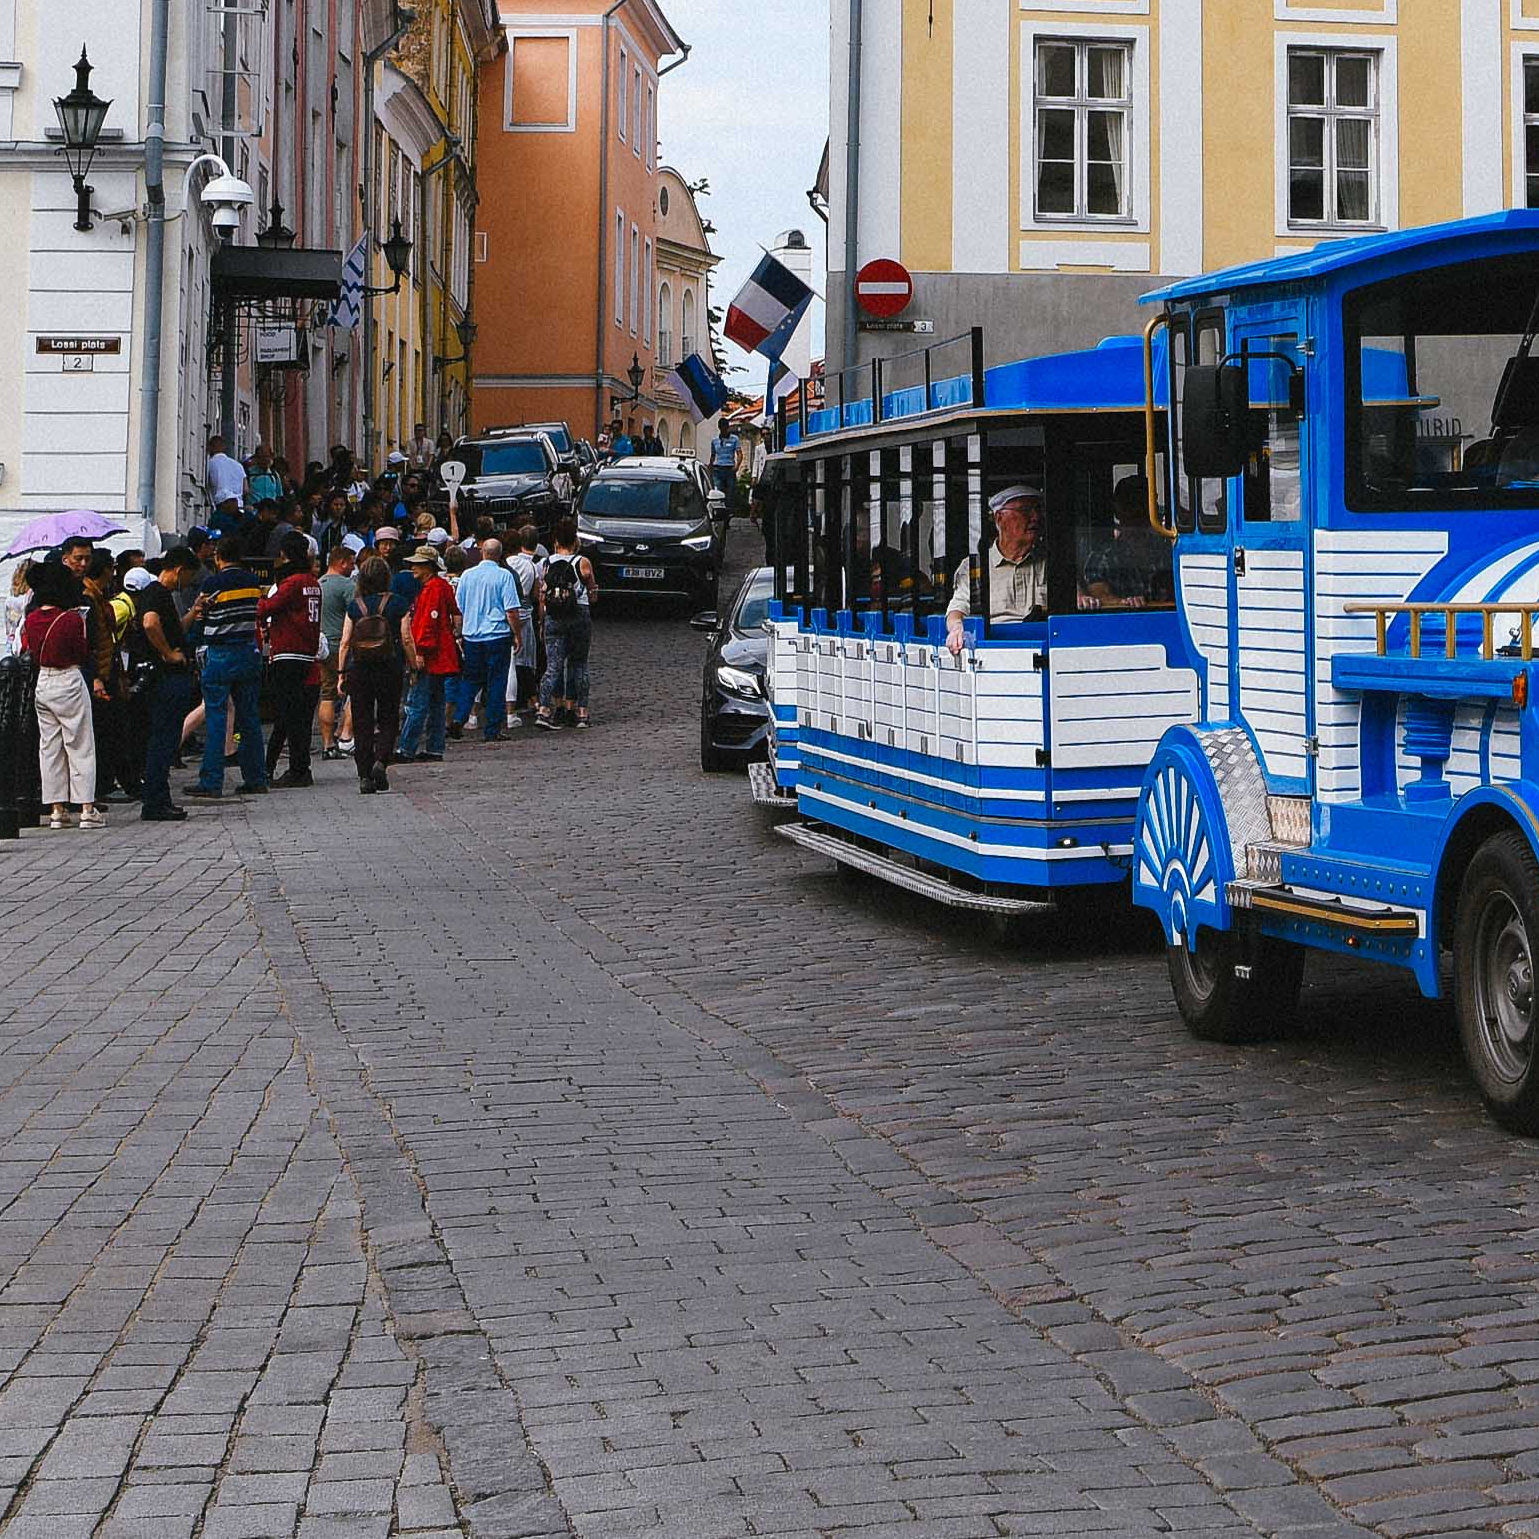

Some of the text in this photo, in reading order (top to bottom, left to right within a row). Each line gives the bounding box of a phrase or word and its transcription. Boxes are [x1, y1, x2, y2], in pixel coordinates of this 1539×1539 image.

[920, 322, 927, 331] 3
[51, 339, 106, 351] Lossi plats
[73, 357, 82, 368] 2
[449, 465, 455, 476] 1
